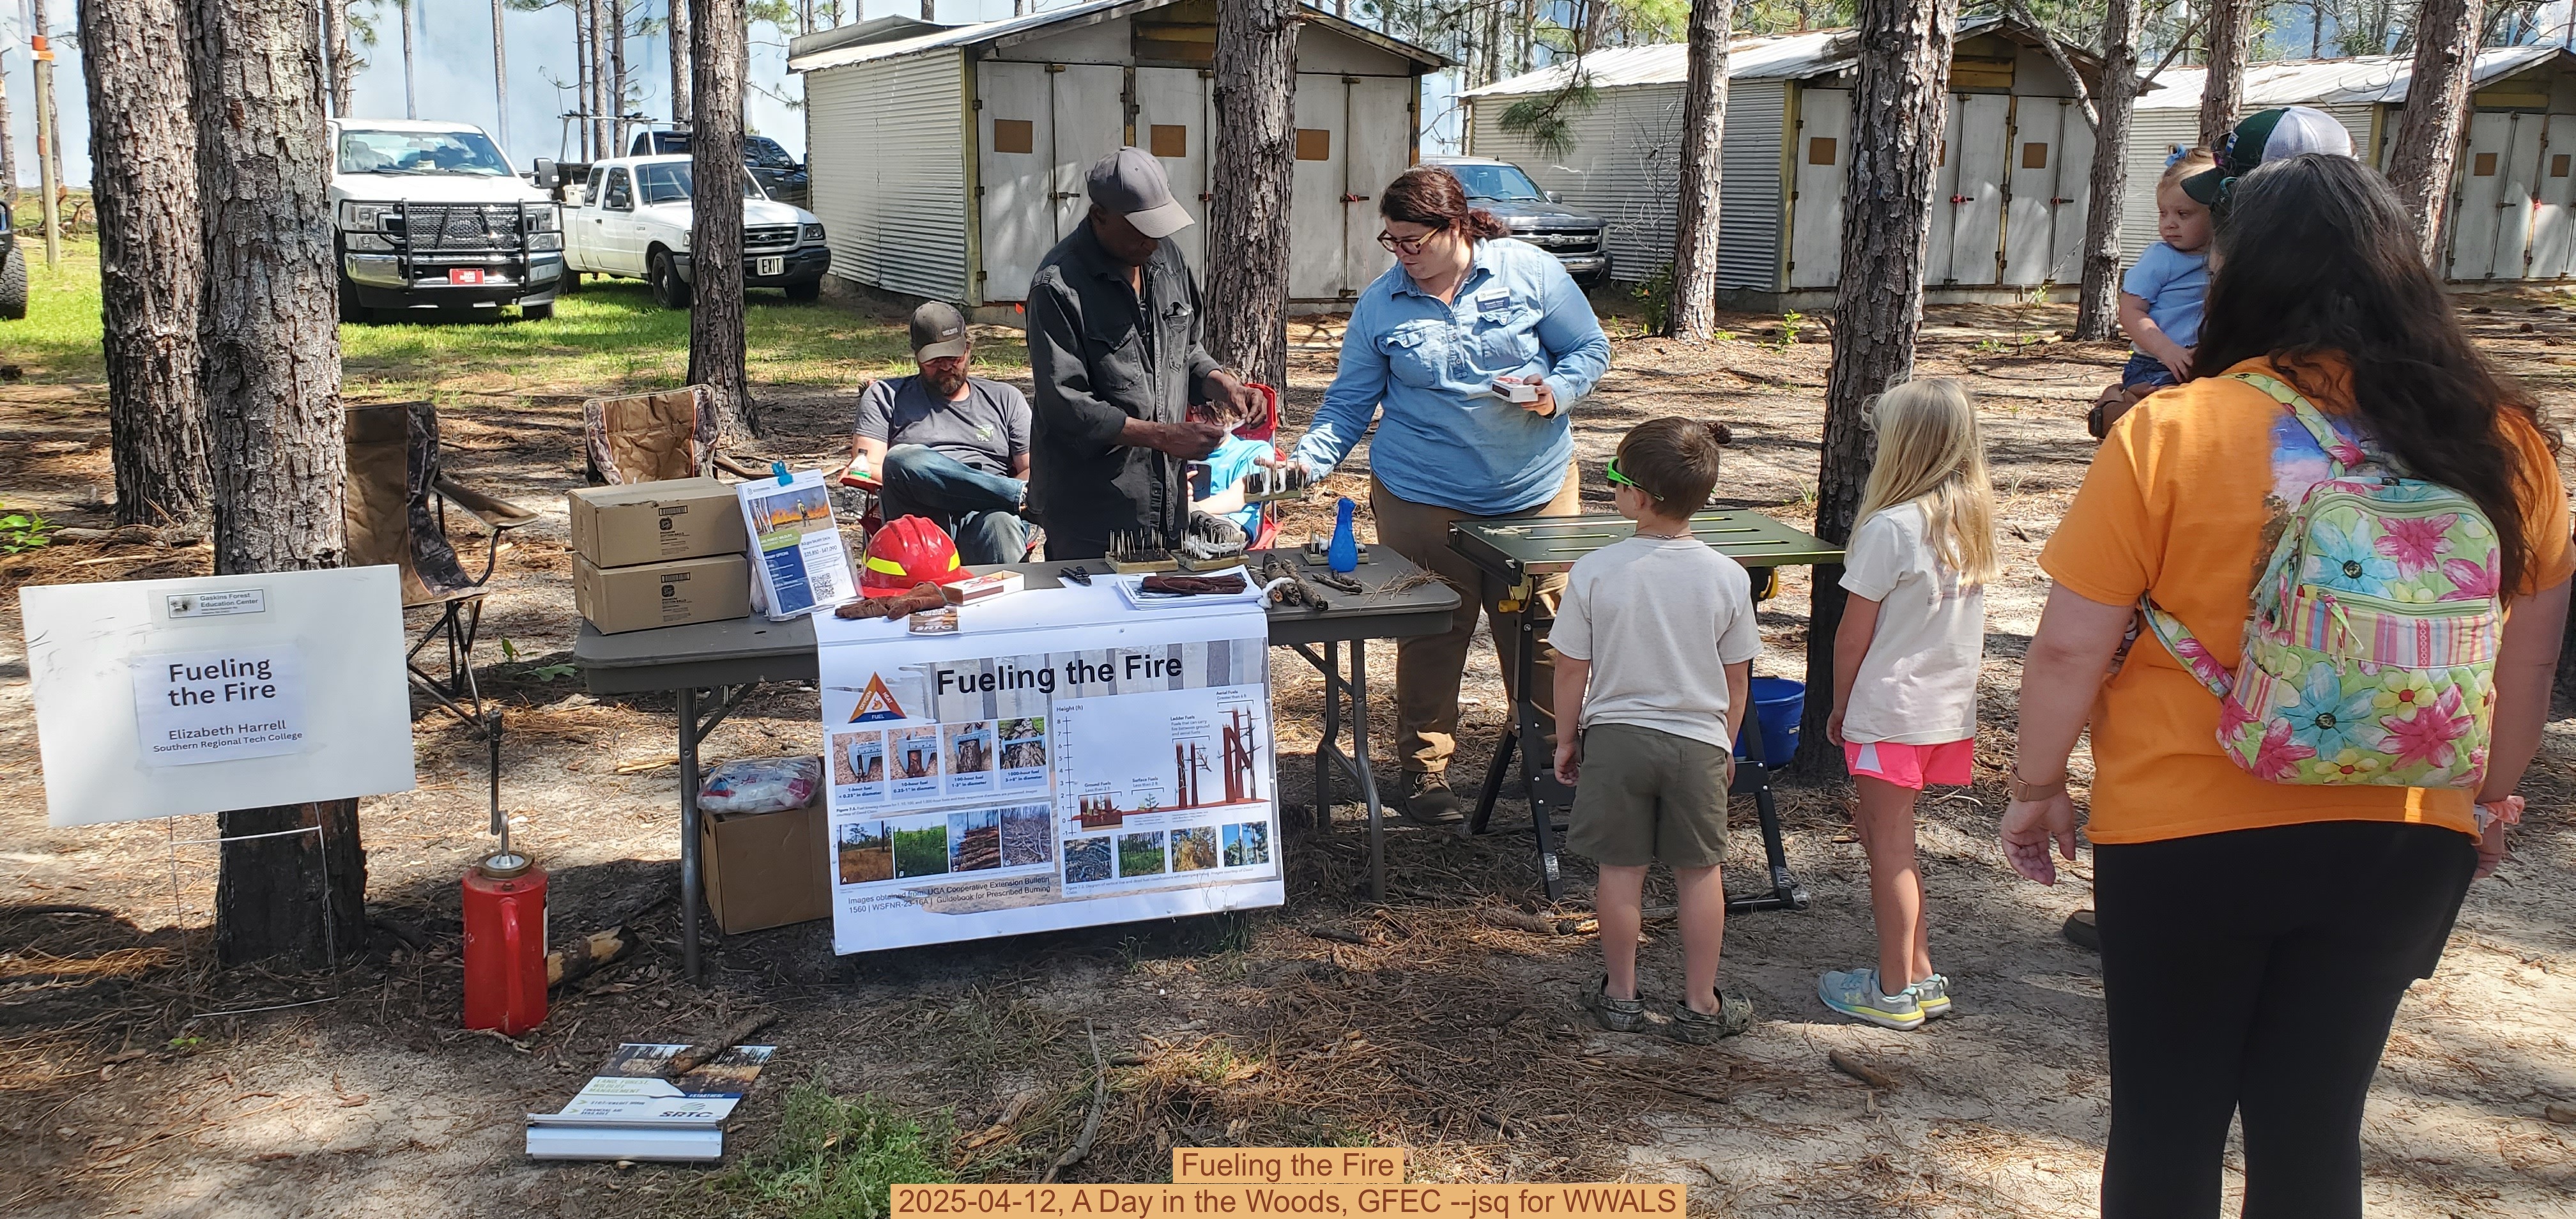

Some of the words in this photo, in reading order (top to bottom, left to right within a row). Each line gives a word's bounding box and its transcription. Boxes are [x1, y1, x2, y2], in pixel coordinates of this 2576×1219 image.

[762, 258, 780, 273] EXIT
[169, 658, 272, 682] Fueling
[937, 666, 1055, 694] Fueling
[1066, 659, 1114, 685] the
[1125, 654, 1183, 680] Fire
[168, 686, 215, 707] the
[225, 682, 276, 702] Fire
[859, 690, 872, 710] OXYGEN
[882, 691, 894, 703] HEAT
[169, 724, 234, 740] Elizabeth
[238, 719, 287, 733] Harrell
[153, 743, 198, 753] Southern
[201, 737, 241, 749] Regional
[268, 732, 303, 741] College
[848, 896, 874, 905] Images
[876, 892, 906, 900] obtained
[946, 884, 988, 893] Cooperative
[990, 879, 1023, 888] Extension
[849, 905, 866, 914] 1560
[873, 899, 929, 910] WSFNR-23-16A
[937, 894, 974, 903] Guidebook
[986, 887, 1022, 898] Prescribed
[1024, 885, 1050, 894] Burning
